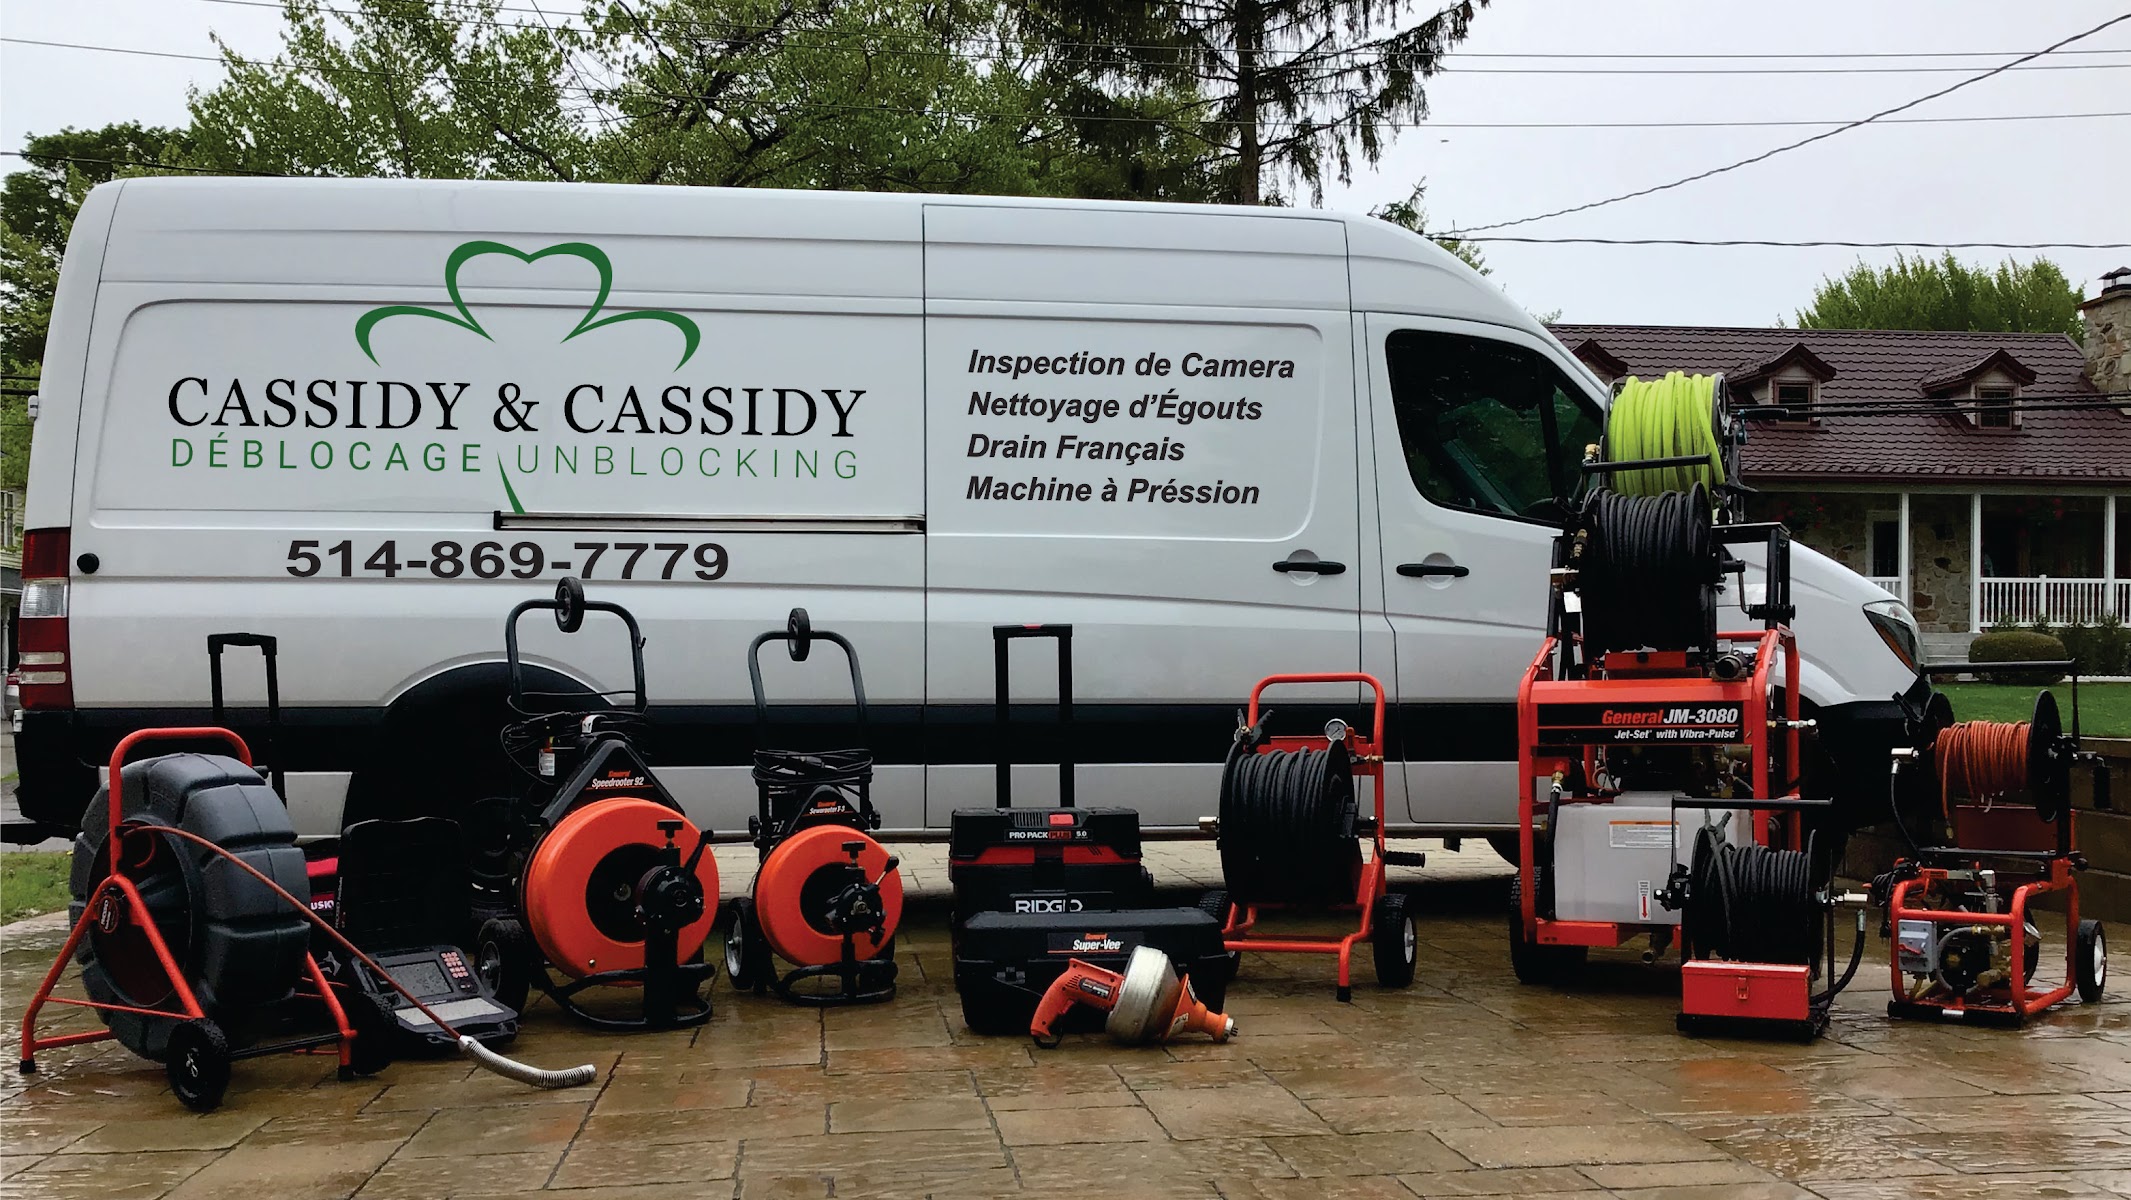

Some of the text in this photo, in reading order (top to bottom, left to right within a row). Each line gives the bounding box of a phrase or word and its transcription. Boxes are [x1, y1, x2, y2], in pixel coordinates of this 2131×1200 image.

[967, 349, 1295, 380] Inspection de Camera
[168, 376, 867, 438] CASSIDY & CASSIDY
[967, 391, 1120, 424] Nettoyage
[172, 431, 857, 480] DÉBLOCAGE UNBLOCKING
[966, 433, 1186, 466] Drain Français
[966, 476, 1260, 504] Machine à Préssion
[286, 539, 729, 580] 514-869-7779
[1601, 708, 1739, 724] General JM-3080
[1656, 729, 1678, 739] with
[591, 776, 645, 789] Speedrooter 92
[1009, 831, 1026, 839] PRO
[1027, 831, 1048, 839] PACK
[1015, 899, 1083, 913] RIDGID
